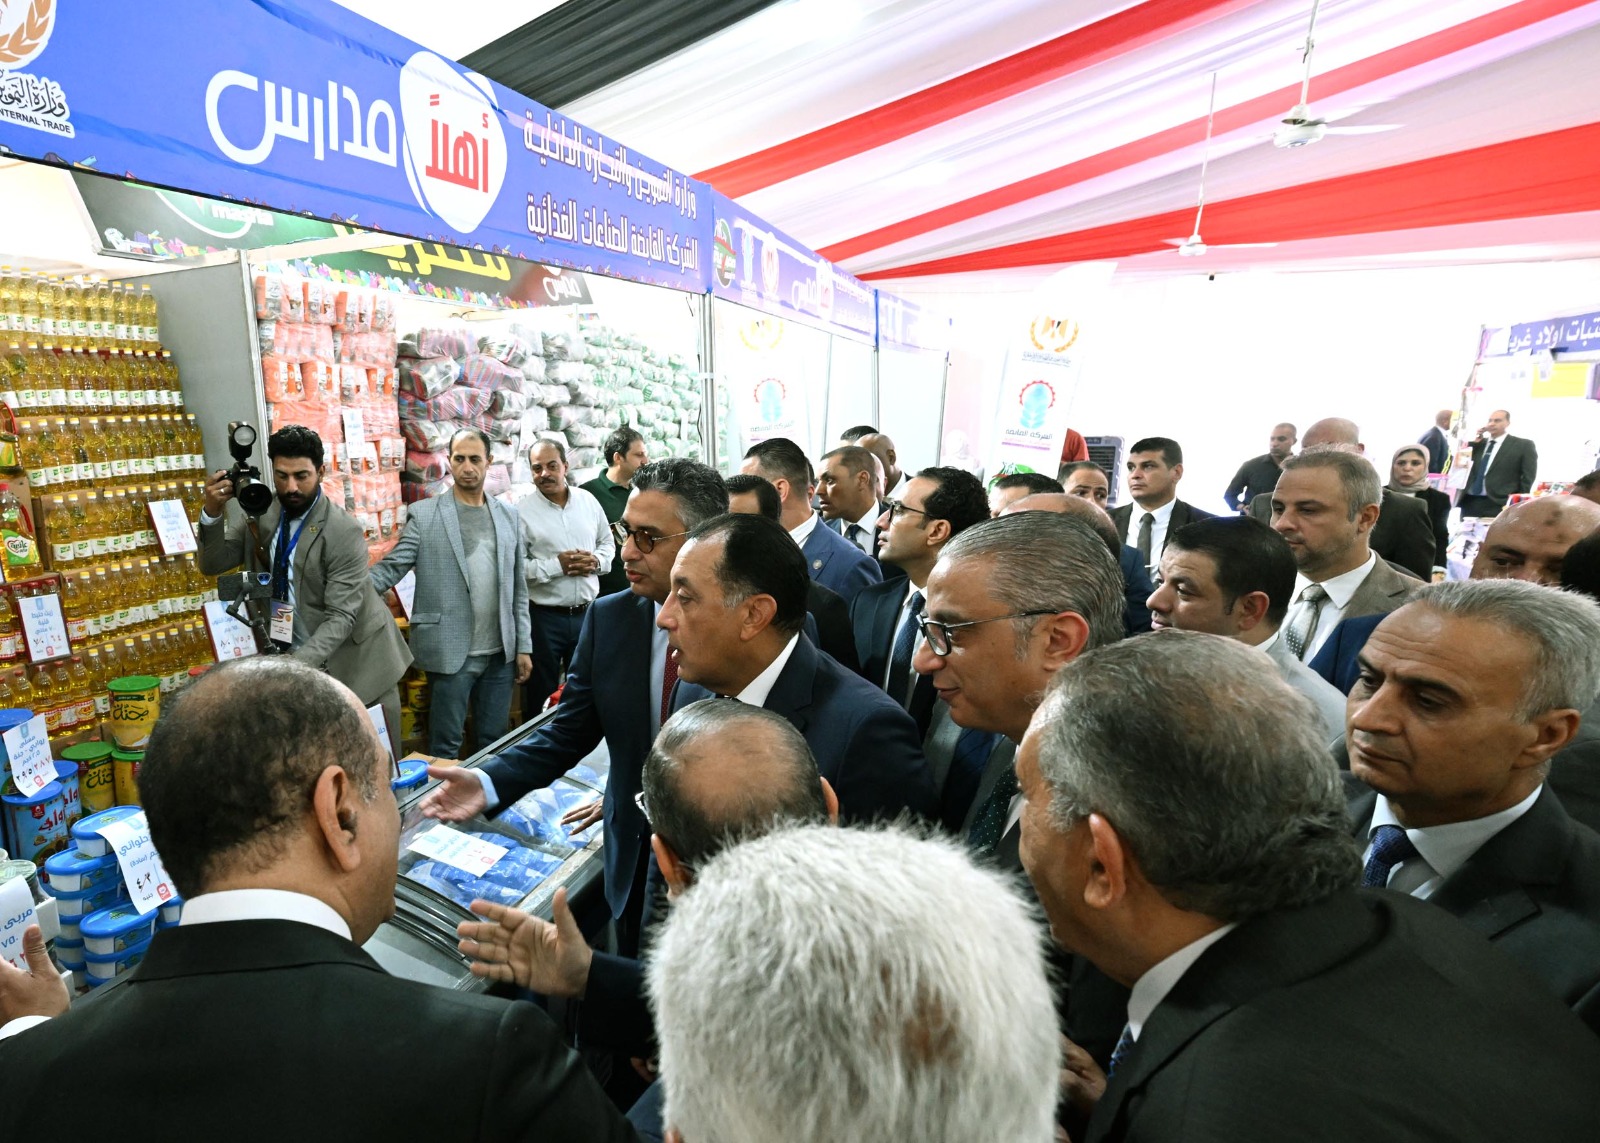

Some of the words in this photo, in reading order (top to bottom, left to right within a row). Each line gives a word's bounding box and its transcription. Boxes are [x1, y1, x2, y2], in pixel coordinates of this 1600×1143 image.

[0, 108, 40, 125] NTERNAL
[41, 118, 71, 134] TRADE
[205, 70, 397, 167] مدارس
[523, 110, 581, 169] الداخلية
[526, 193, 578, 243] الغذائية
[674, 176, 697, 220] وزارة
[581, 207, 628, 253] للصناعات
[631, 225, 665, 267] القابضة
[666, 233, 698, 274] الشركة
[1566, 317, 1600, 347] تبات
